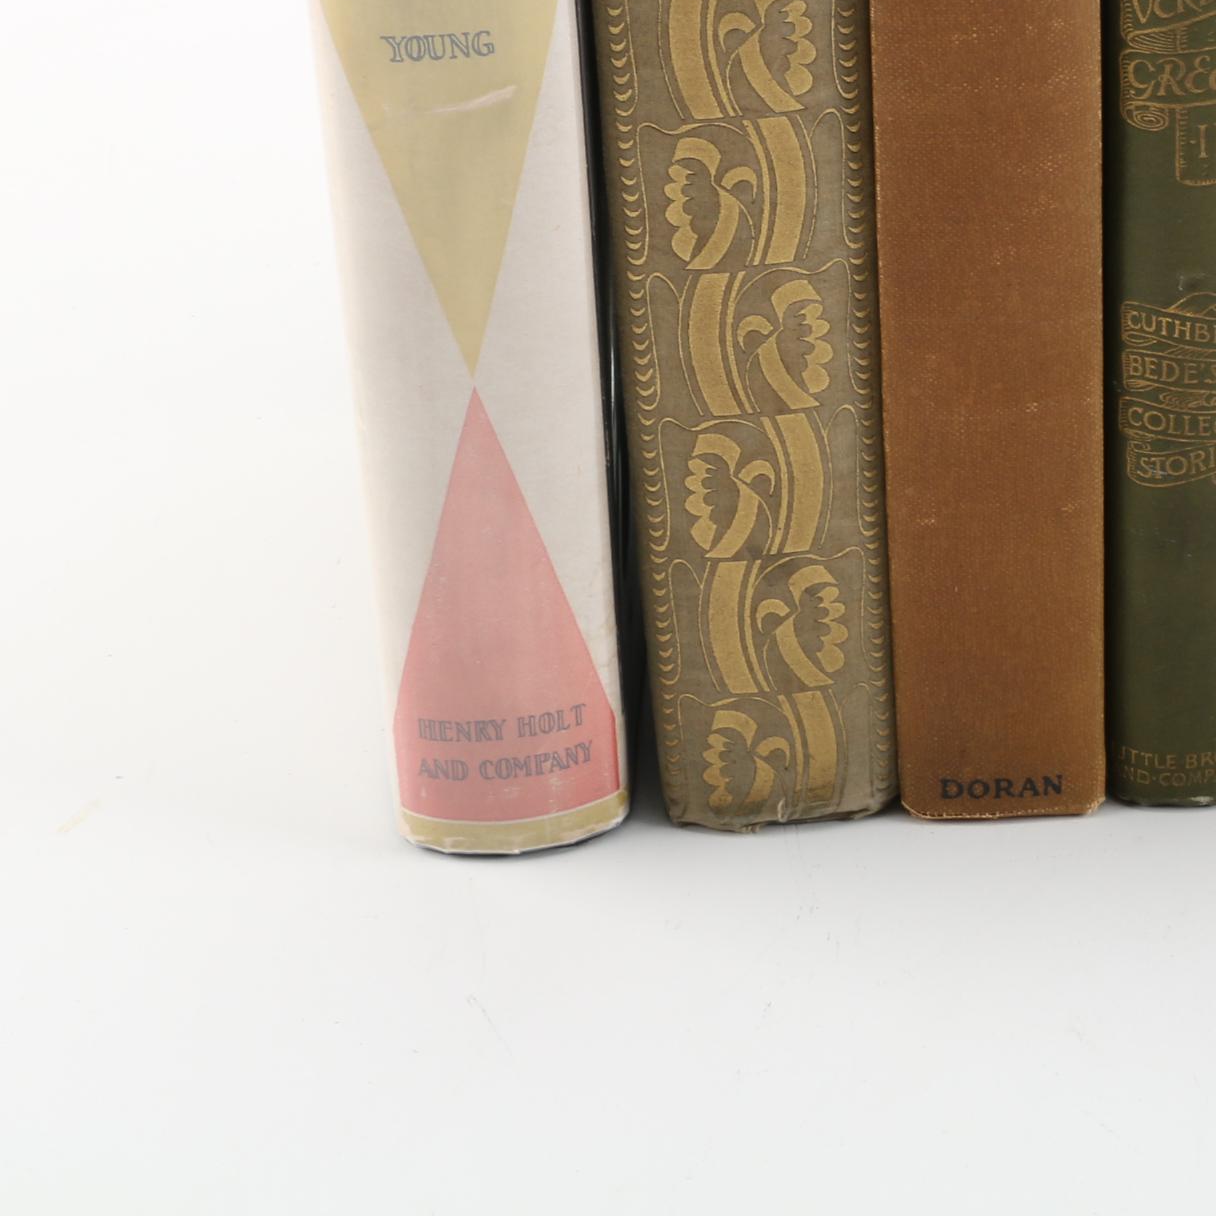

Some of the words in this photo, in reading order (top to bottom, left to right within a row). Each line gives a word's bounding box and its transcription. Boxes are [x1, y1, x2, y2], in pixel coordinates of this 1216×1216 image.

[380, 31, 494, 62] YOUNG
[418, 718, 506, 742] HENRY
[517, 704, 586, 737] HOLT
[419, 758, 468, 781] AND
[479, 740, 592, 780] COMPANY
[939, 774, 1063, 800] DORAN
